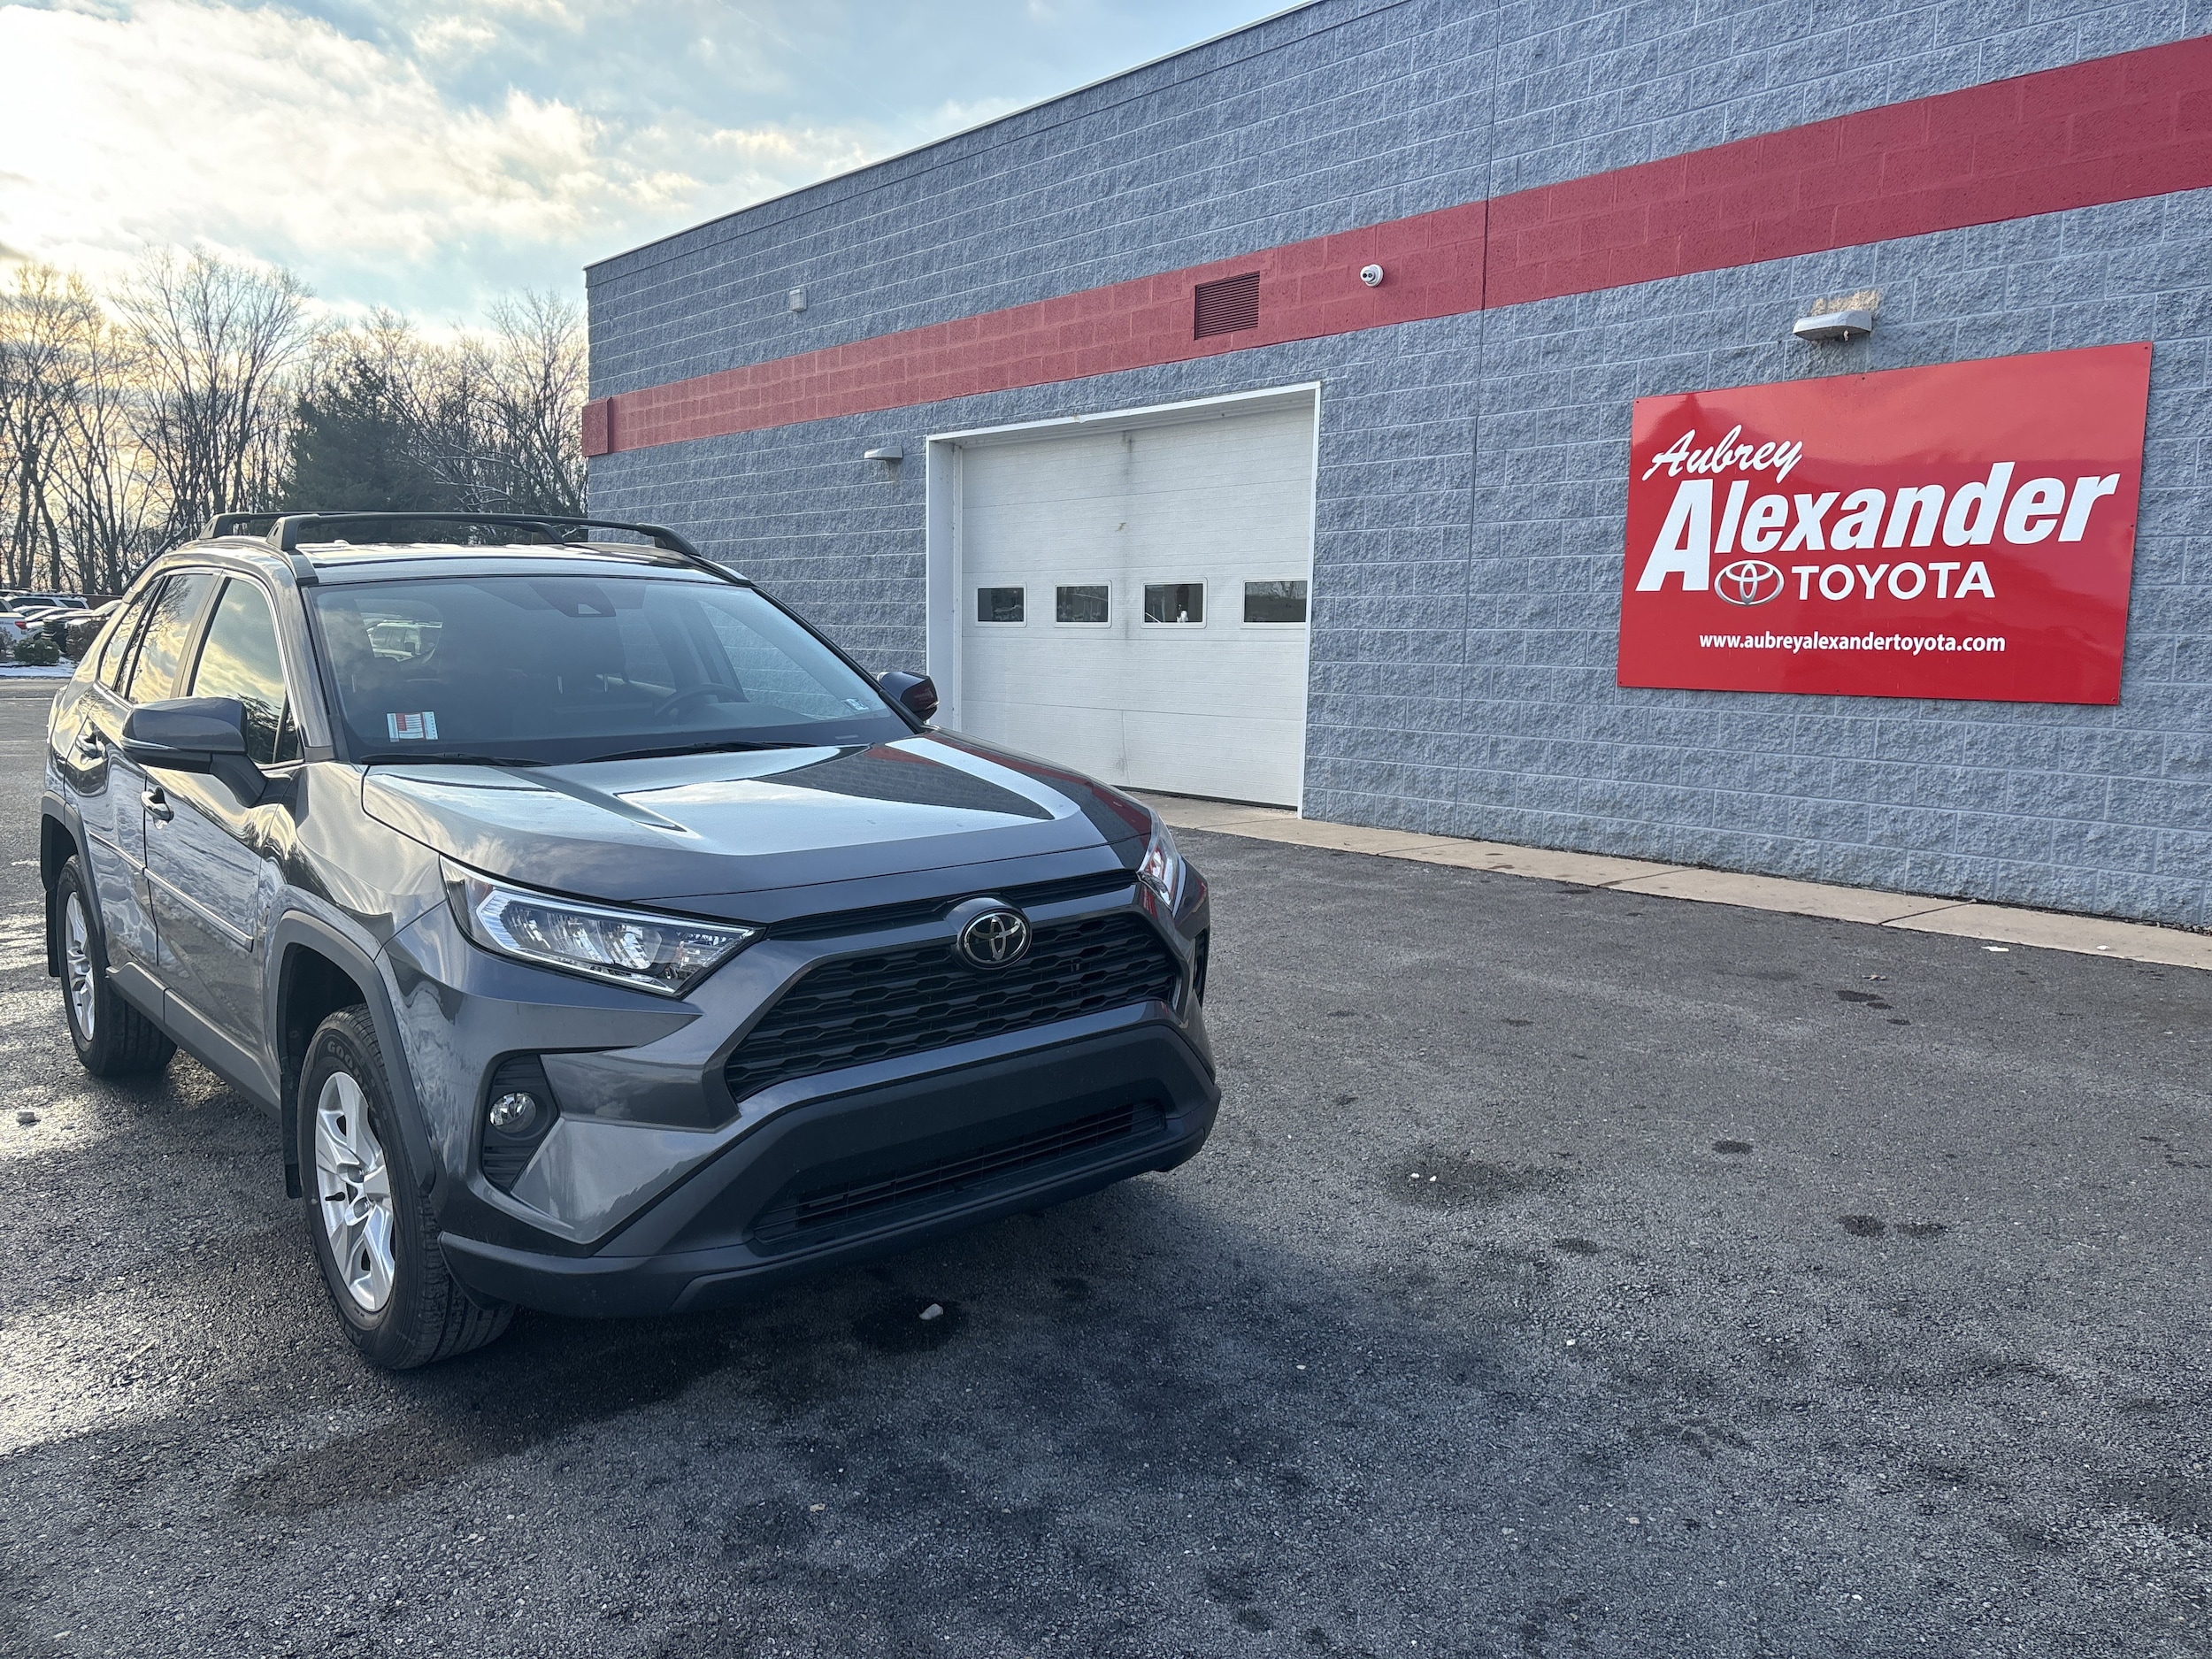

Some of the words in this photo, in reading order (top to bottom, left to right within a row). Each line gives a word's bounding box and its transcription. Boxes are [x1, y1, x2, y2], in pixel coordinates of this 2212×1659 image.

[1641, 424, 1803, 484] Aubrey
[1635, 461, 2122, 592] Alexander
[1791, 561, 1996, 601] TOYOTA
[1699, 630, 2006, 656] www.aubreyalexandertoyota.com
